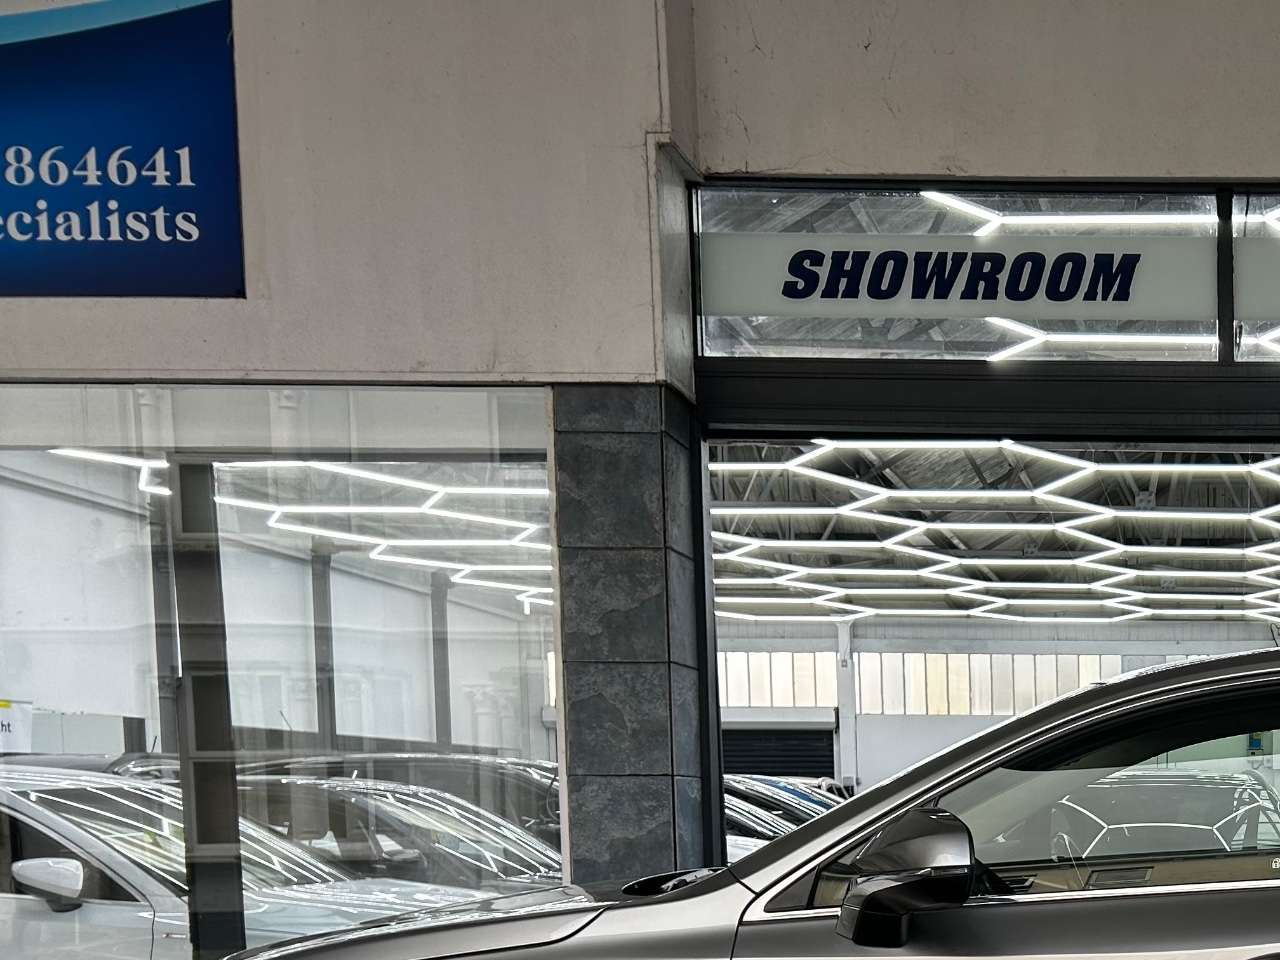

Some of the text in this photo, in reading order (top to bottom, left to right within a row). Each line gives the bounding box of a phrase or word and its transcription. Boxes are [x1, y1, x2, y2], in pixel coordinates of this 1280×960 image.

[4, 145, 196, 187] 864641
[0, 199, 200, 242] cialists
[781, 249, 1141, 302] SHOWROOM
